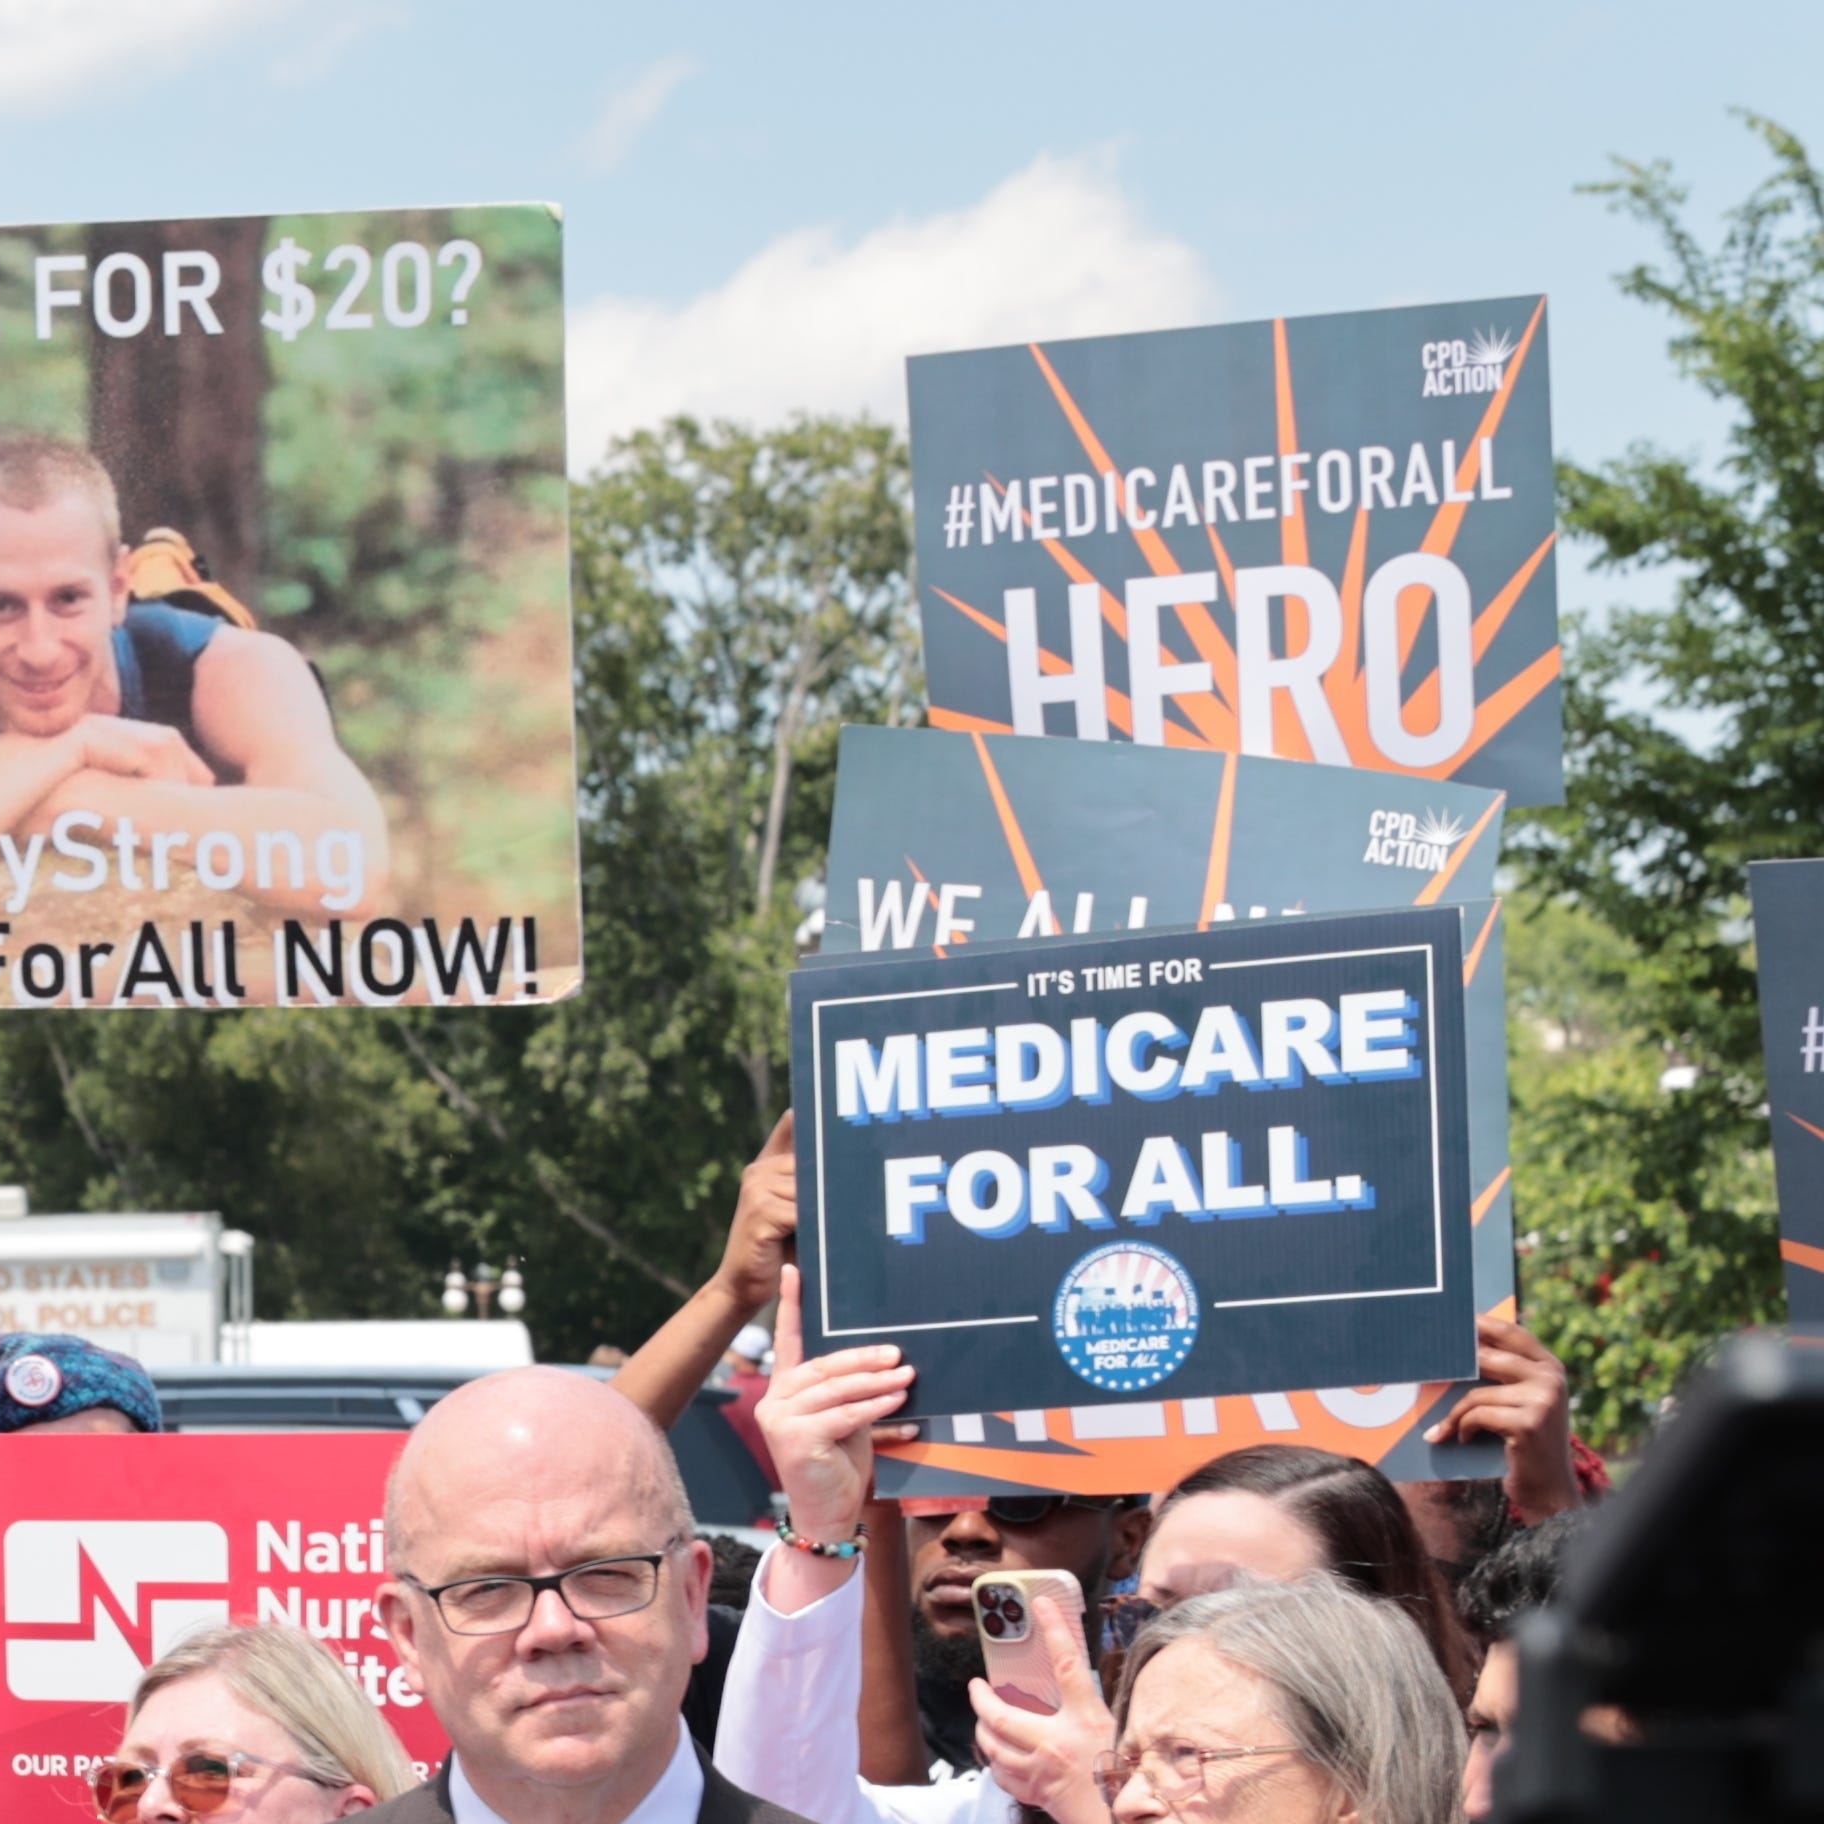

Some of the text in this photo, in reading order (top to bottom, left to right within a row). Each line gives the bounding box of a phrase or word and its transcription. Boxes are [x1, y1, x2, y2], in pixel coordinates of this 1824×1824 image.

[35, 251, 224, 341] FOR
[261, 237, 483, 344] $20?
[1421, 340, 1468, 369] CPD
[1423, 364, 1504, 397] ACTION
[944, 436, 1512, 548] #MEDICAREFORALL
[1004, 552, 1476, 769] HERO
[1368, 810, 1416, 840] CPD
[1363, 835, 1449, 872] ACTION
[284, 917, 539, 1000] NOW!
[1027, 959, 1202, 997] IT'S TIME FOR
[834, 989, 1419, 1123] MEDICARE
[884, 1126, 1374, 1243] FOR ALL.
[25, 1264, 149, 1291] STATES
[37, 1301, 156, 1329] POLICE
[1086, 1335, 1170, 1355] MEDICARE
[1093, 1353, 1160, 1370] FOR ALL
[12, 1754, 67, 1776] OUR
